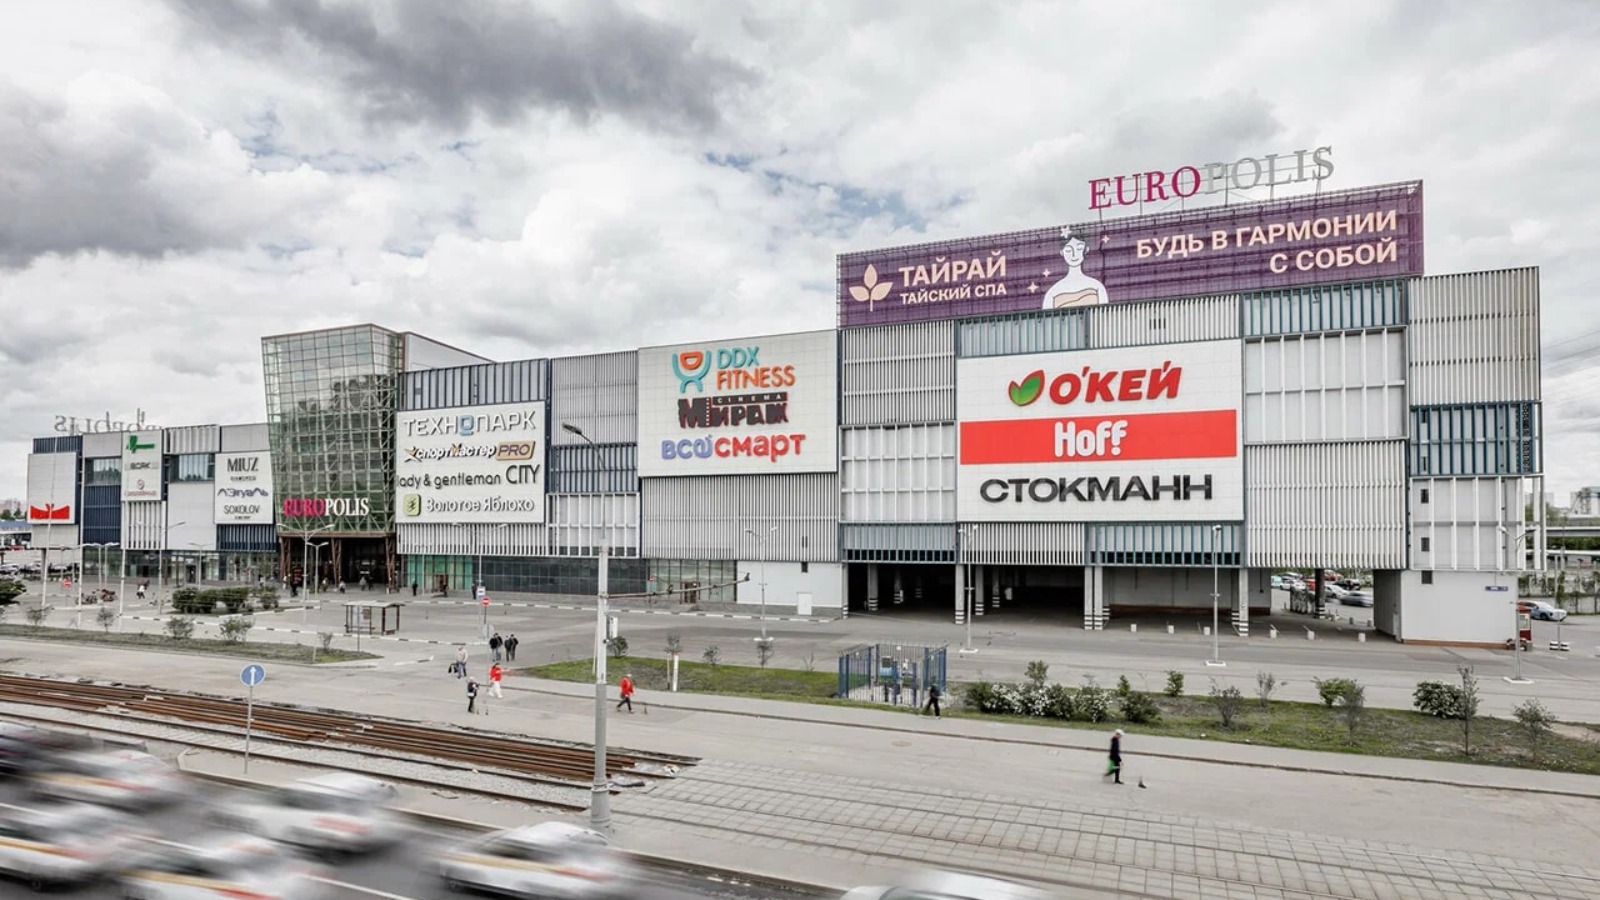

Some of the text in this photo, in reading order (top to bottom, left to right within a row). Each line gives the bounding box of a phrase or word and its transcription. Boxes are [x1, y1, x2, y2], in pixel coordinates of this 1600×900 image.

[1088, 146, 1334, 209] EUROPOLIS
[1137, 210, 1397, 258] БУДЬ В ГАРМОНИИ
[1269, 237, 1397, 274] С СОБОЙ
[898, 250, 1006, 287] ТАЙРАЙ
[900, 283, 1007, 305] ТАЙСКИЙ СПА
[717, 346, 759, 370] DDX
[717, 365, 796, 391] FITNESS
[718, 394, 782, 404] CINEMA
[404, 410, 536, 437] ТЕХНОПАРК
[497, 444, 531, 457] PRO
[227, 456, 259, 472] MIUZ
[423, 473, 431, 486] &
[434, 472, 501, 490] gentleman
[505, 464, 540, 484] CITY
[980, 474, 1212, 502] СТОКМАНН
[223, 504, 260, 514] SOKOLOV
[284, 497, 369, 517] EUROPOLIS
[427, 496, 535, 512] Золотое Яблоко
